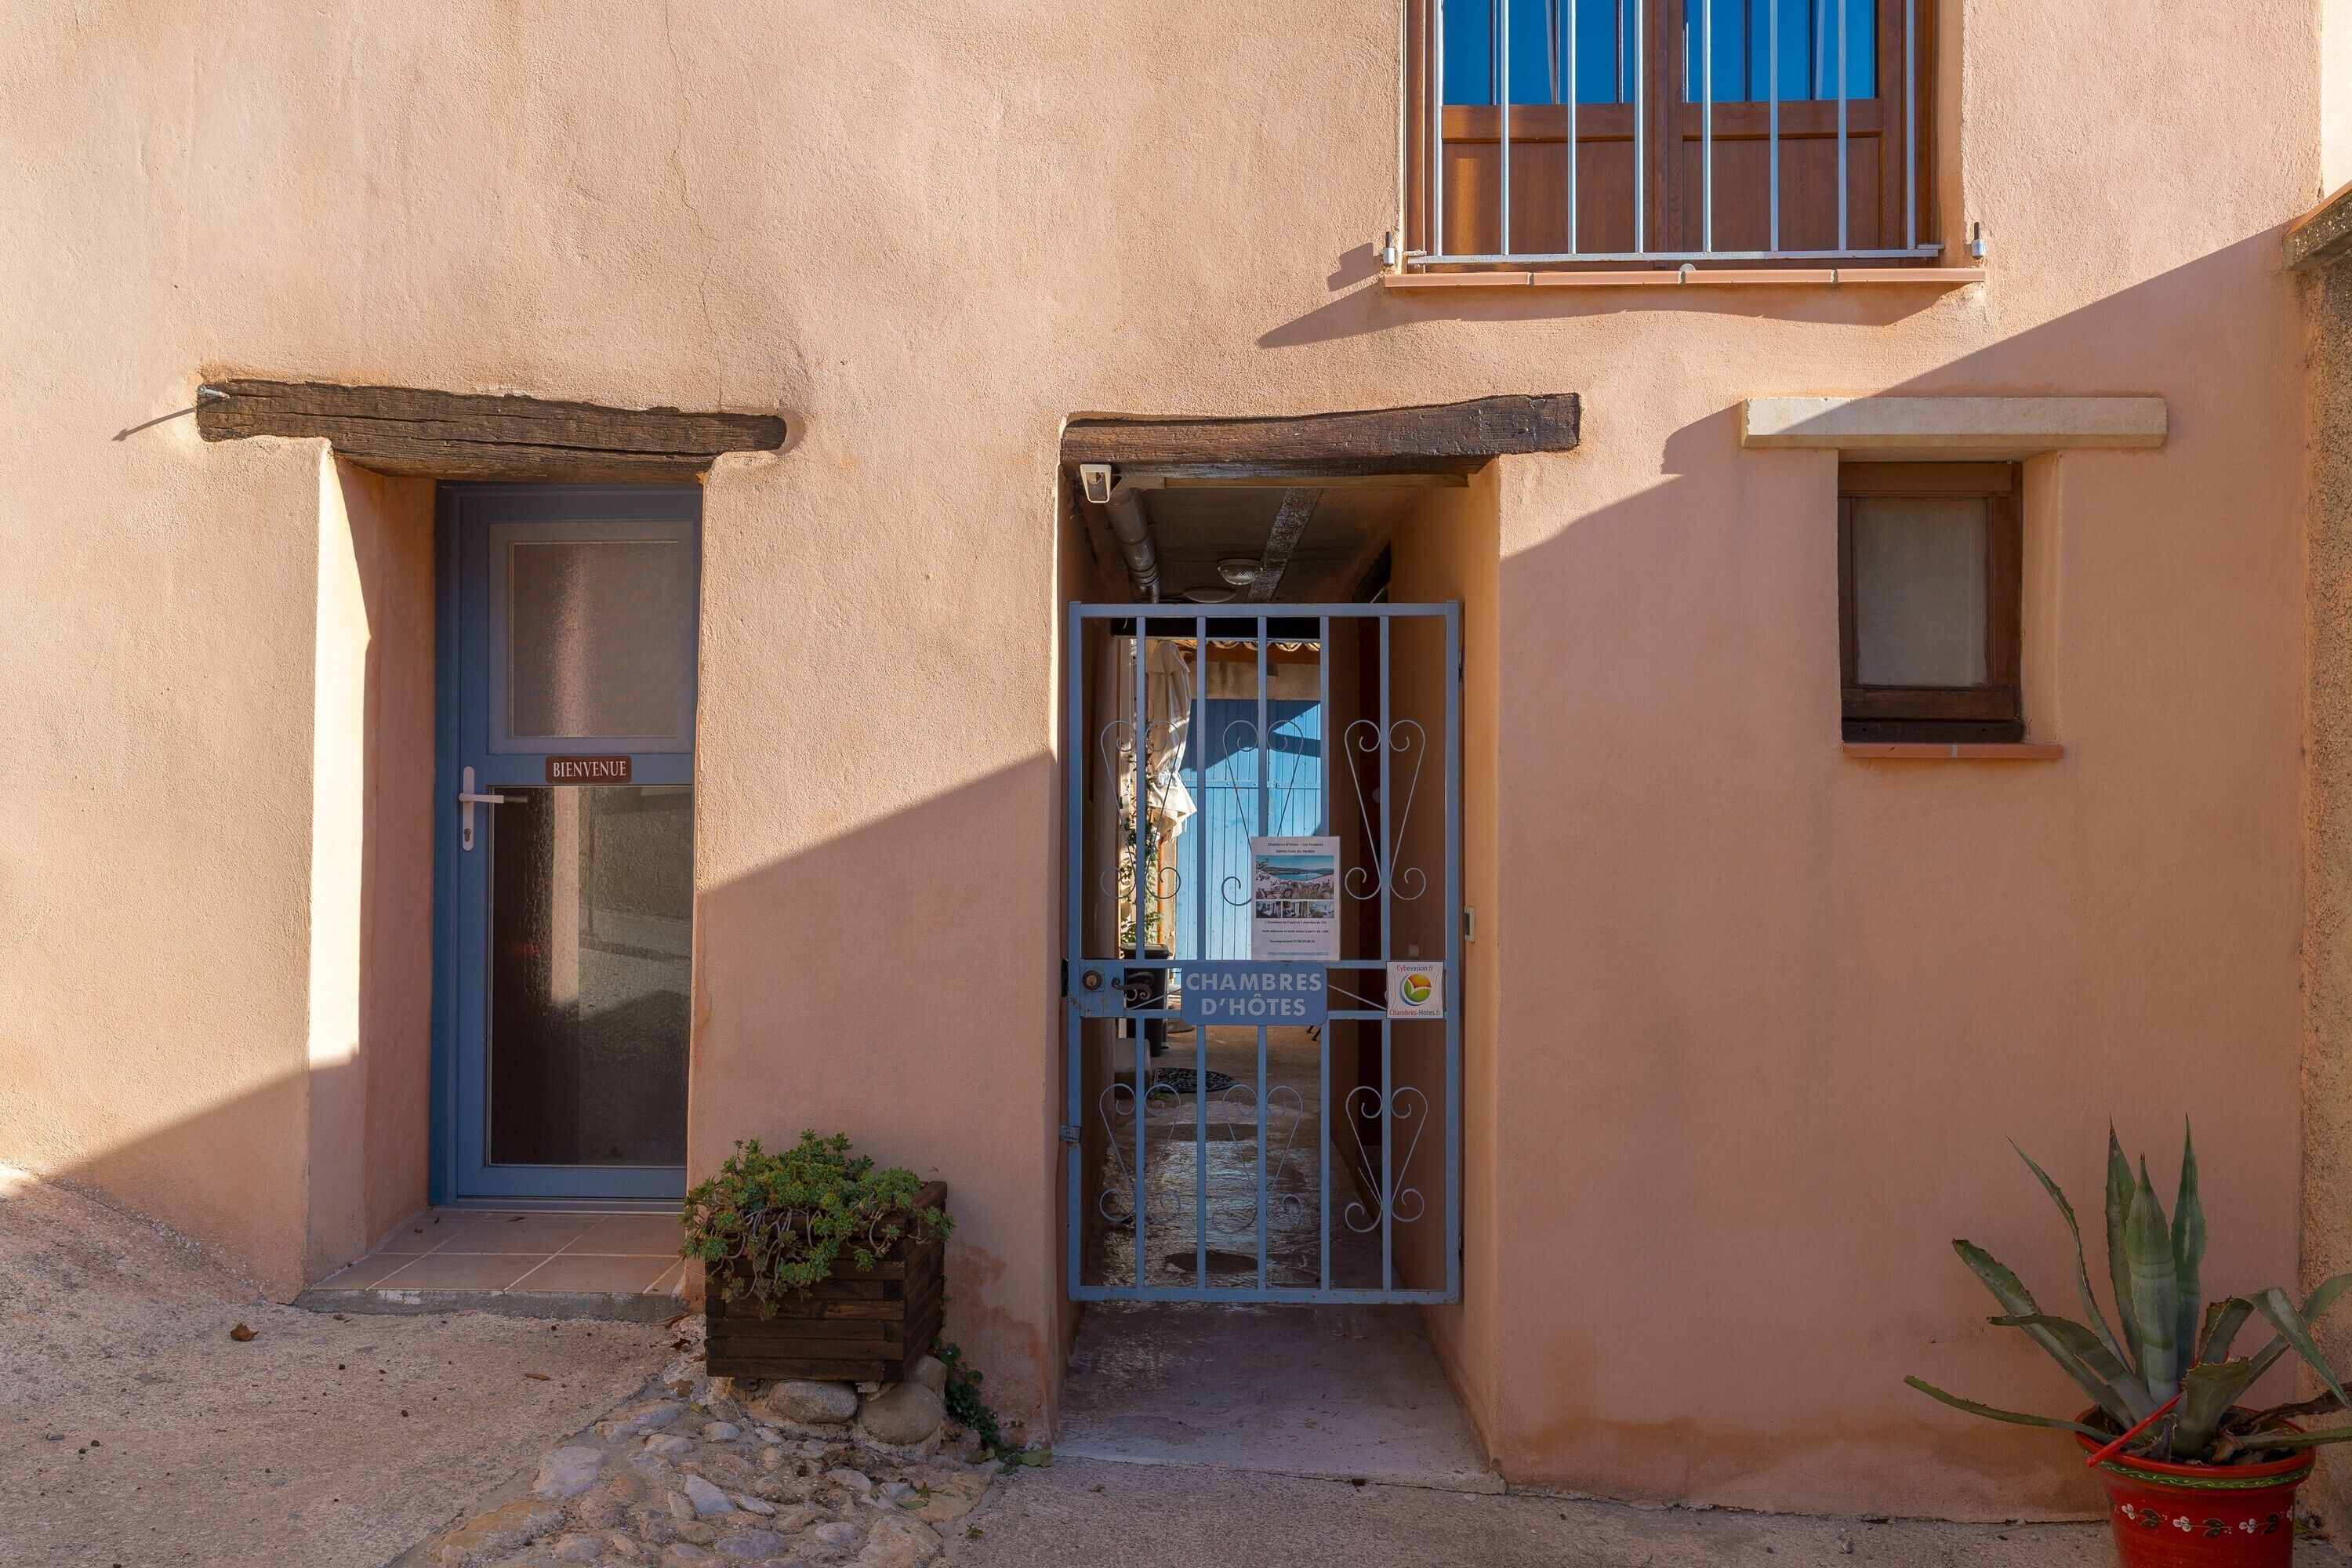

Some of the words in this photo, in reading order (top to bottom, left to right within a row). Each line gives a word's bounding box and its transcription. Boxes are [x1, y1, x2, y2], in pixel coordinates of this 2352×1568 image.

[553, 760, 626, 778] BIENVENUE
[1185, 973, 1322, 991] CHAMBRES
[1201, 993, 1306, 1016] D'HÔTES
